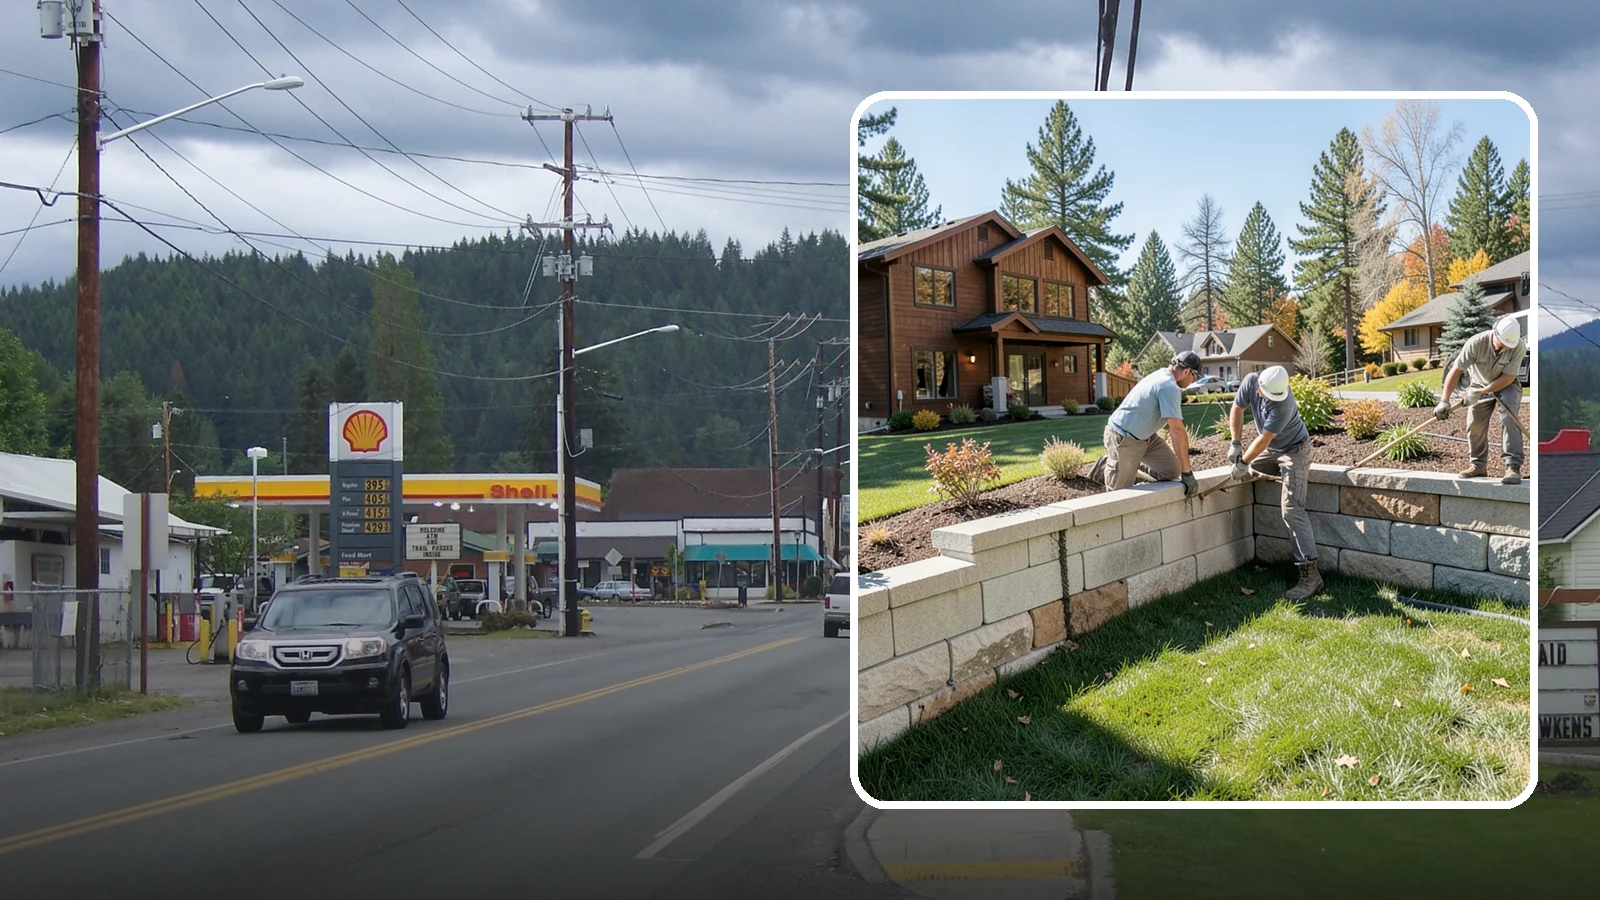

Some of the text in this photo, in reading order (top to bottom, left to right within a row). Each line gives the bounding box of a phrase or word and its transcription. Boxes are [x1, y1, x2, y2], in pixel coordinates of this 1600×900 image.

[366, 480, 384, 490] 395
[490, 484, 547, 498] Shell
[366, 494, 384, 504] 405
[366, 508, 383, 518] 415
[366, 522, 384, 532] 429
